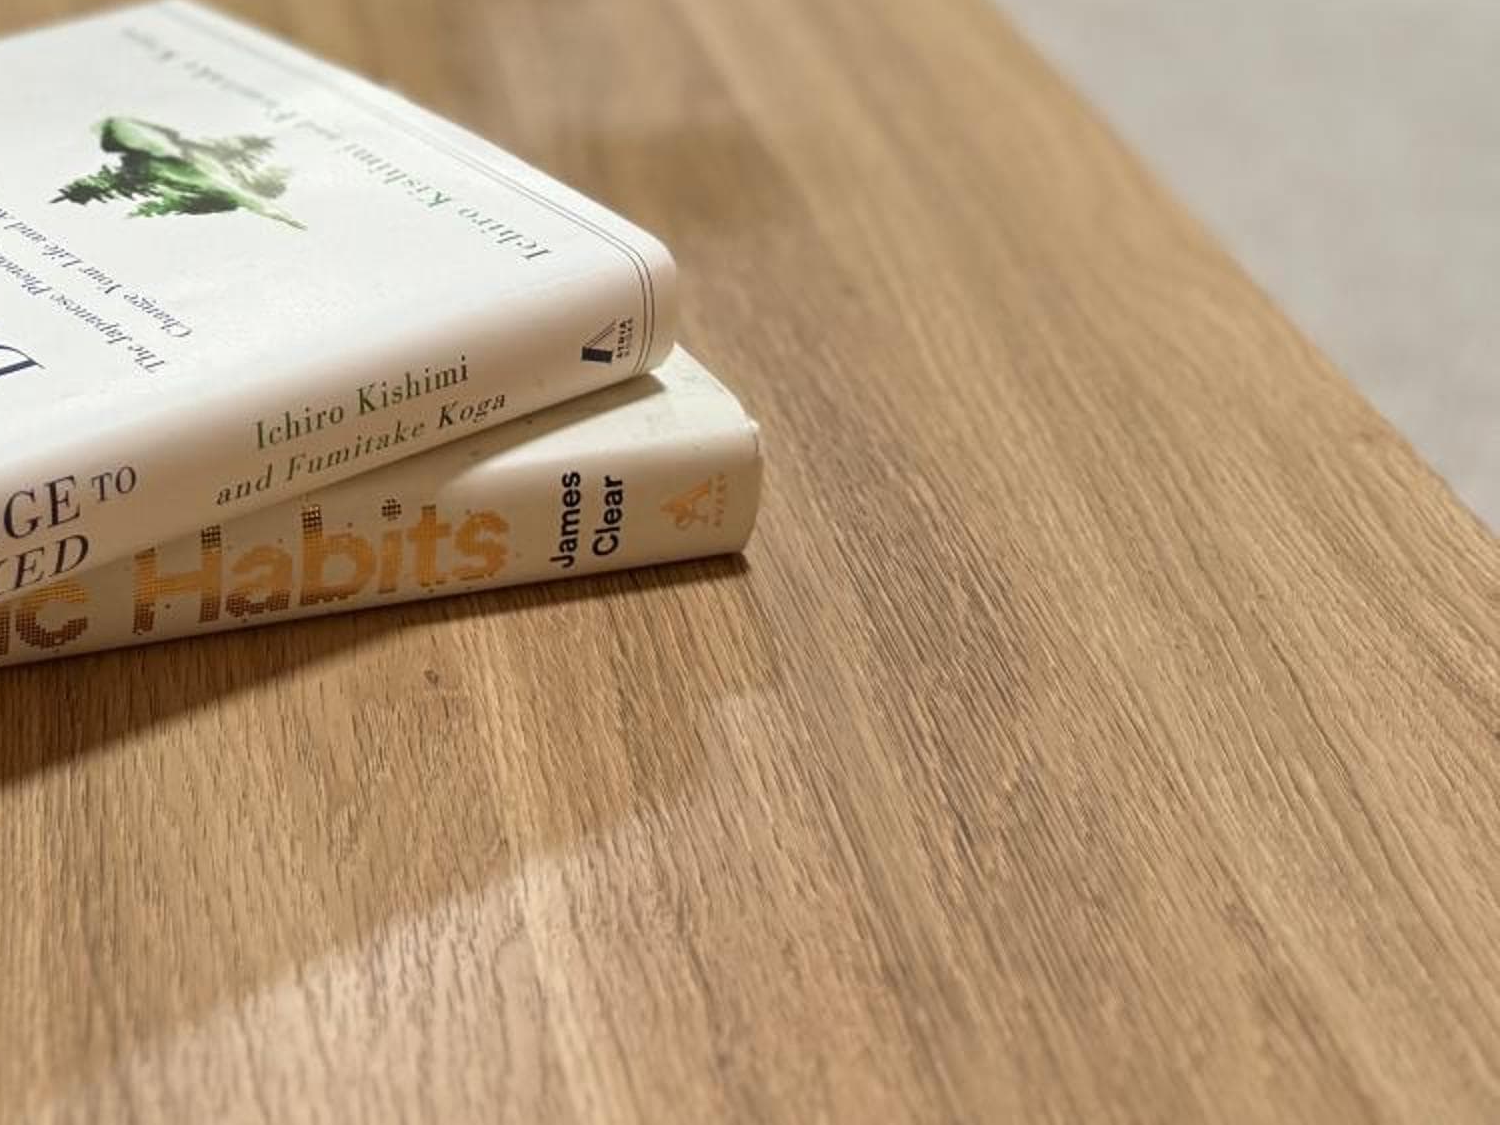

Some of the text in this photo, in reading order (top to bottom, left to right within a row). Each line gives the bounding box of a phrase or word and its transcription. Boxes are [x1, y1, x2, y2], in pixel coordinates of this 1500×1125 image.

[3, 221, 47, 243] and
[42, 244, 84, 268] Life
[79, 266, 122, 294] Your
[50, 293, 132, 344] Japanese
[123, 293, 192, 338] Change
[127, 345, 165, 373] The
[255, 355, 470, 451] Ichiro Kishimi
[216, 393, 506, 505] and Fumitake Koga
[91, 466, 137, 503] TO
[550, 471, 581, 569] James
[592, 475, 624, 557] Clear
[132, 497, 510, 635] Habits
